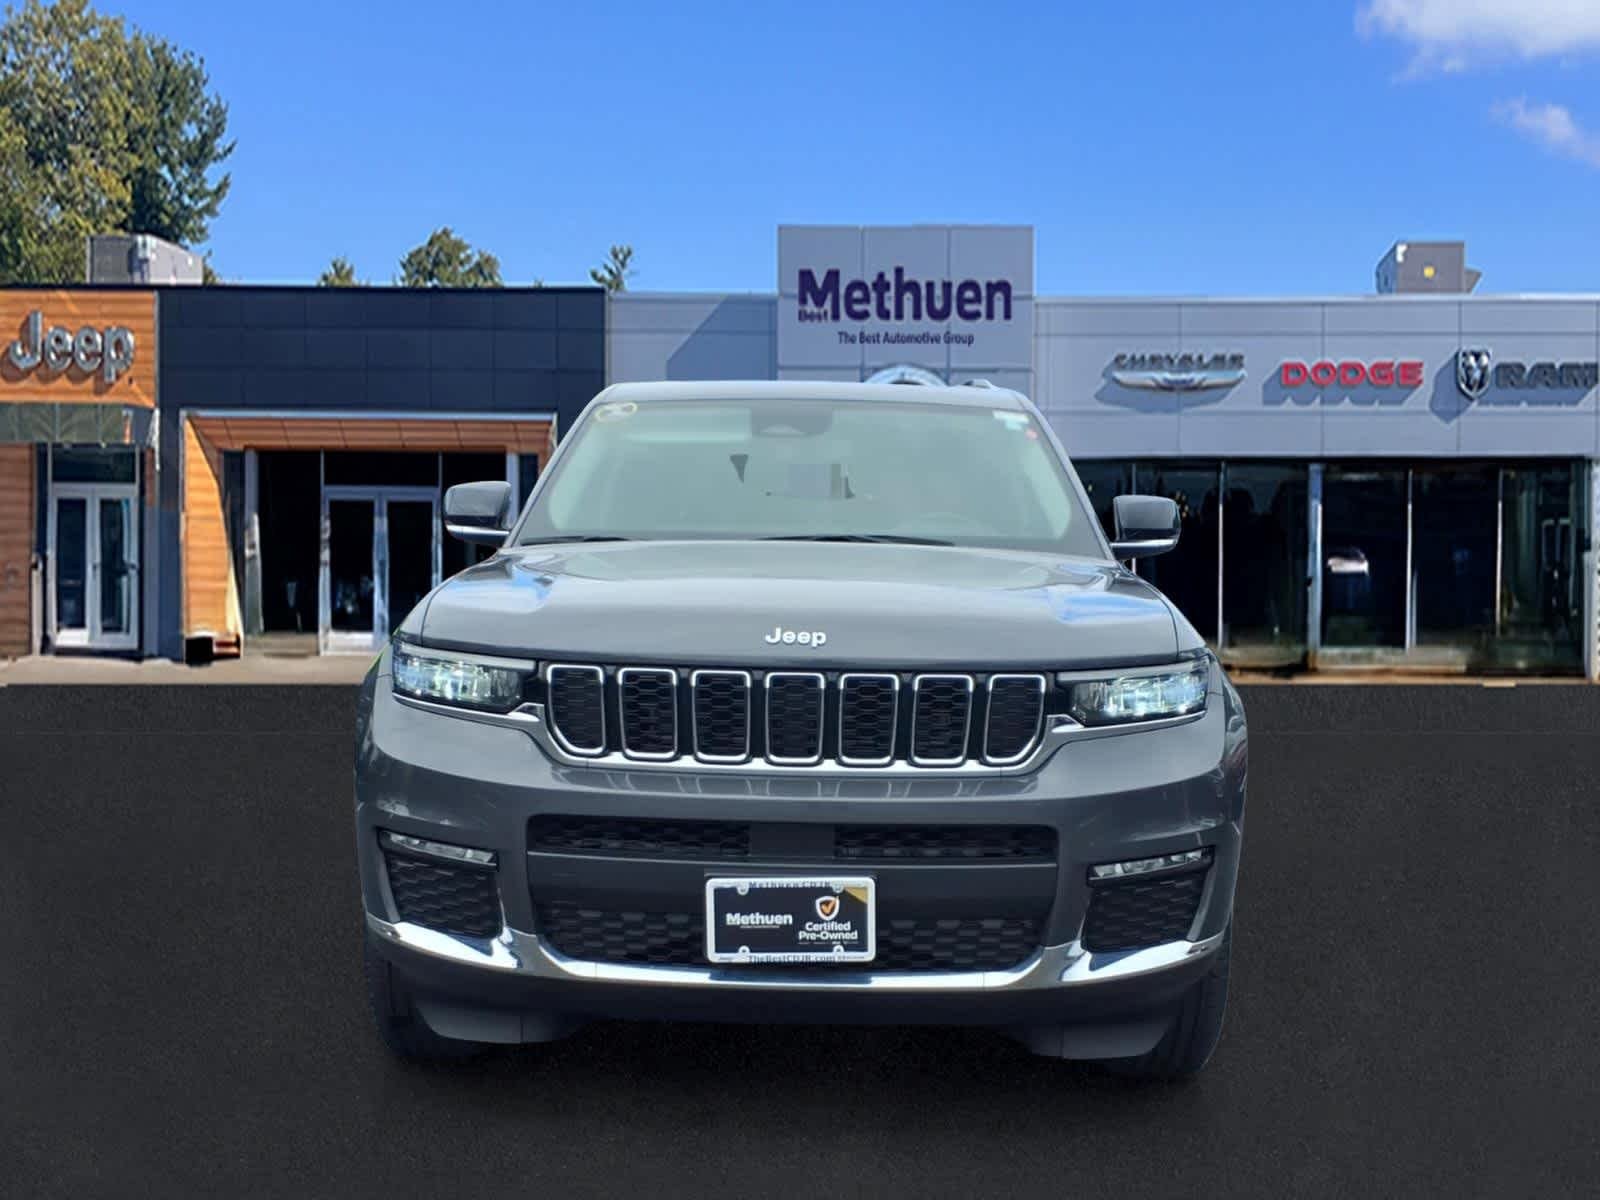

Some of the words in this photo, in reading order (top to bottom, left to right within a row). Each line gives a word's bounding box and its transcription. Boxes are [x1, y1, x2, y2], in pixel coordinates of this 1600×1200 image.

[798, 266, 1012, 321] Methuen
[798, 309, 829, 322] Best
[838, 331, 857, 345] The
[859, 331, 880, 344] Best
[883, 331, 941, 344] Automotive
[943, 331, 974, 346] Group
[9, 310, 135, 384] Jeep
[1114, 353, 1244, 369] CHRYSLER
[1282, 361, 1424, 386] DODGE
[1495, 362, 1599, 388] RAM
[765, 627, 826, 647] Jeep
[726, 912, 793, 925] Methuen
[805, 921, 851, 931] Certified
[799, 930, 858, 940] Pre-Owned
